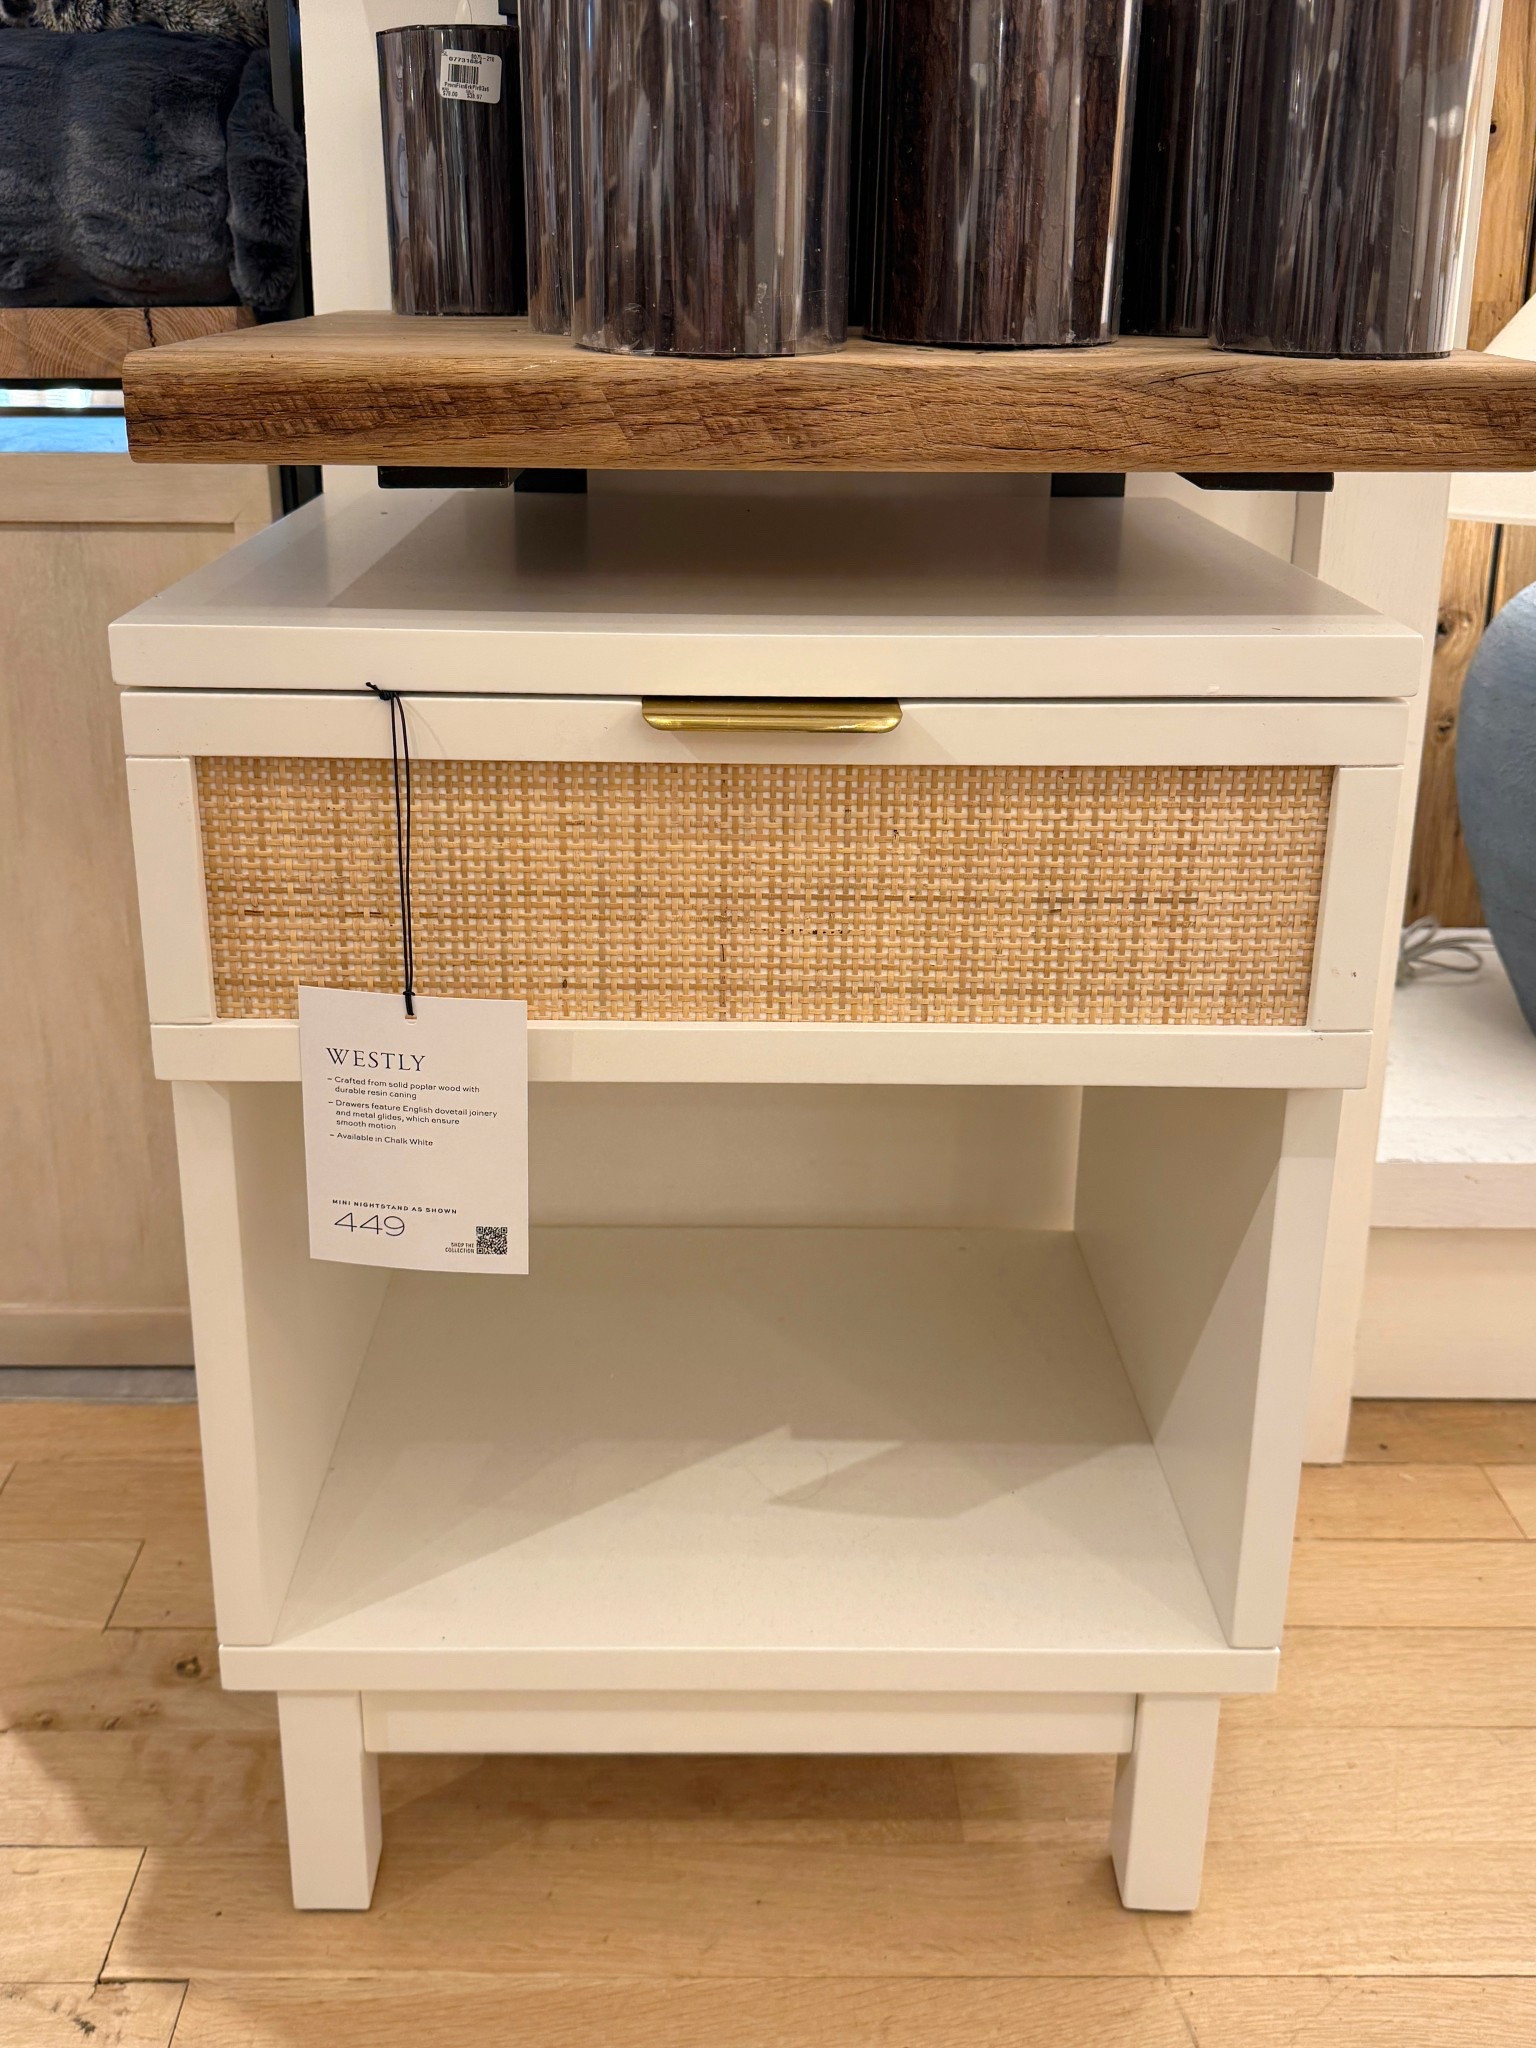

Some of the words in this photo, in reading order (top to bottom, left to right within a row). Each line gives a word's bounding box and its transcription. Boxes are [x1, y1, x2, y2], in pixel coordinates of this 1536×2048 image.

[326, 1047, 426, 1071] WESTLY
[334, 1076, 366, 1085] Crafted
[367, 1079, 387, 1087] from
[388, 1081, 408, 1089] solid
[410, 1083, 436, 1091] poplar
[335, 1086, 366, 1095] durable
[389, 1092, 417, 1100] caning
[335, 1099, 370, 1109] Drawers
[371, 1103, 400, 1111] feature
[402, 1105, 433, 1114] English
[434, 1107, 468, 1116] dovetail
[469, 1110, 497, 1118] joinery
[336, 1120, 366, 1128] smooth
[368, 1122, 396, 1130] motion
[377, 1113, 404, 1122] glides,
[405, 1115, 430, 1123] which
[431, 1117, 460, 1125] ensure
[336, 1132, 373, 1142] Available
[384, 1136, 408, 1145] Chalk
[409, 1138, 433, 1146] White
[353, 1201, 409, 1211] NIGHTSTAND
[334, 1212, 405, 1237] 449
